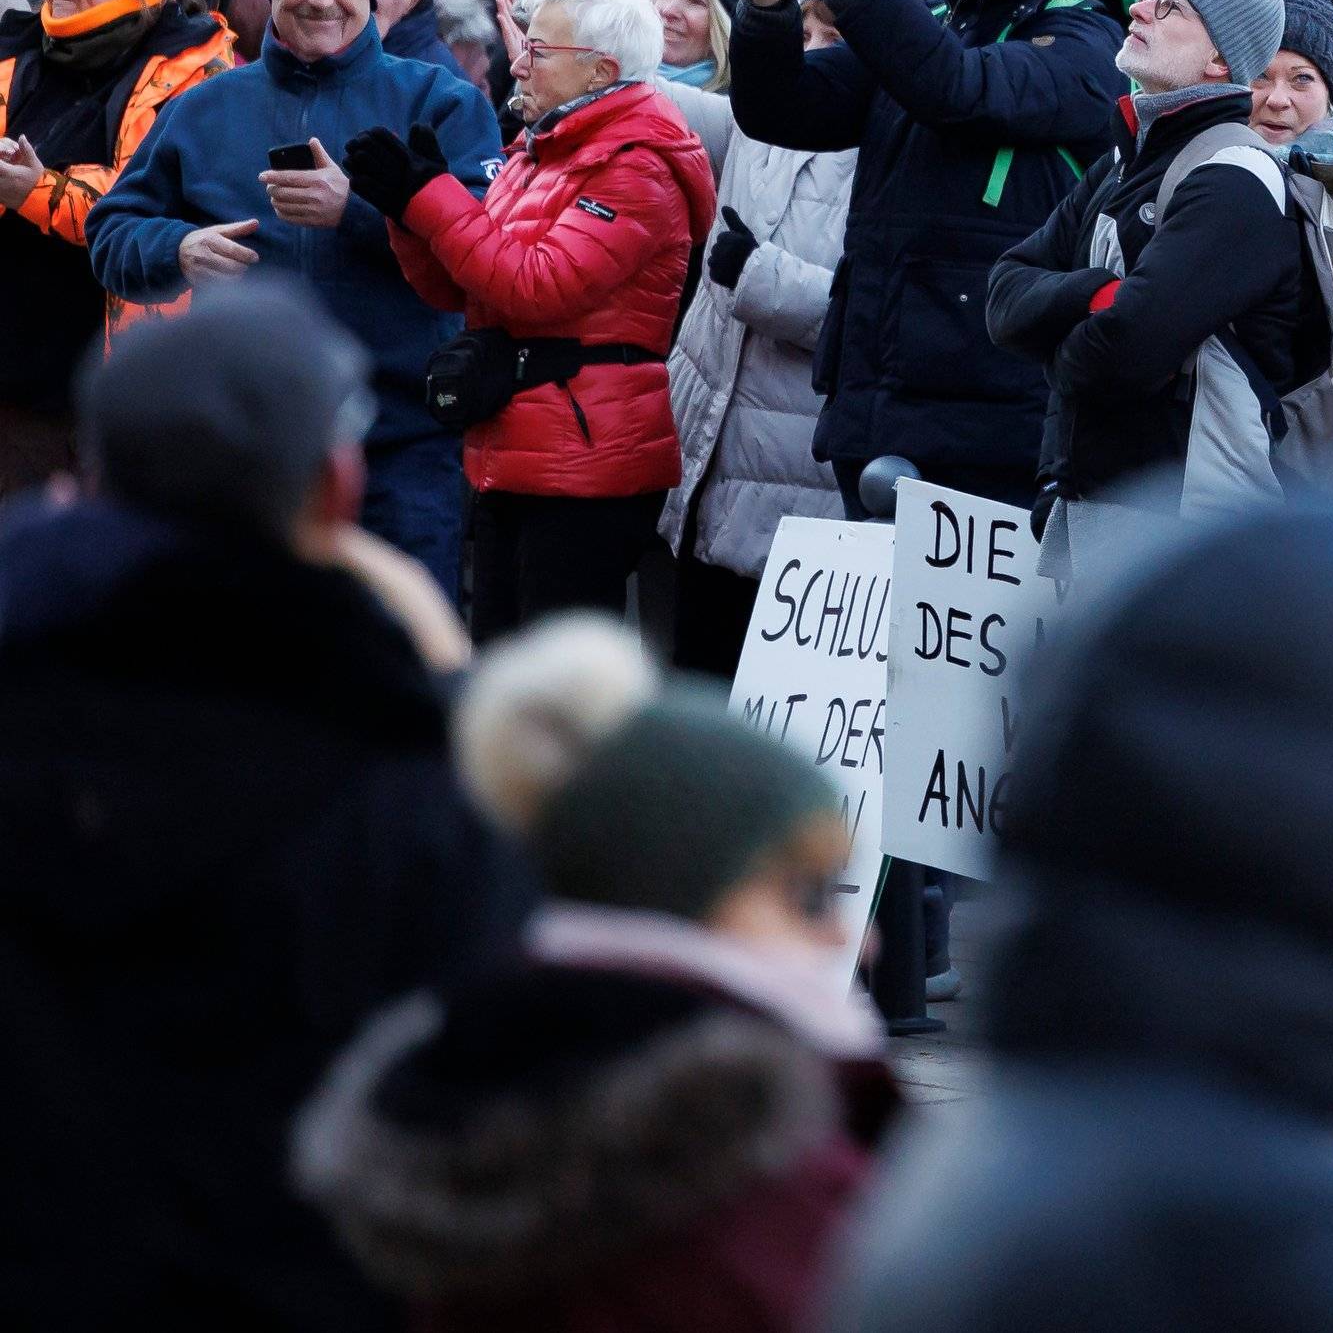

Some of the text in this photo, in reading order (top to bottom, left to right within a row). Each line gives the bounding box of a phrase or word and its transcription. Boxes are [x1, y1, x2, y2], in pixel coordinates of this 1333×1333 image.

[925, 500, 1021, 586] DIE
[760, 558, 890, 662] SCHLU
[914, 601, 1007, 676] DES
[743, 693, 808, 744] MIT
